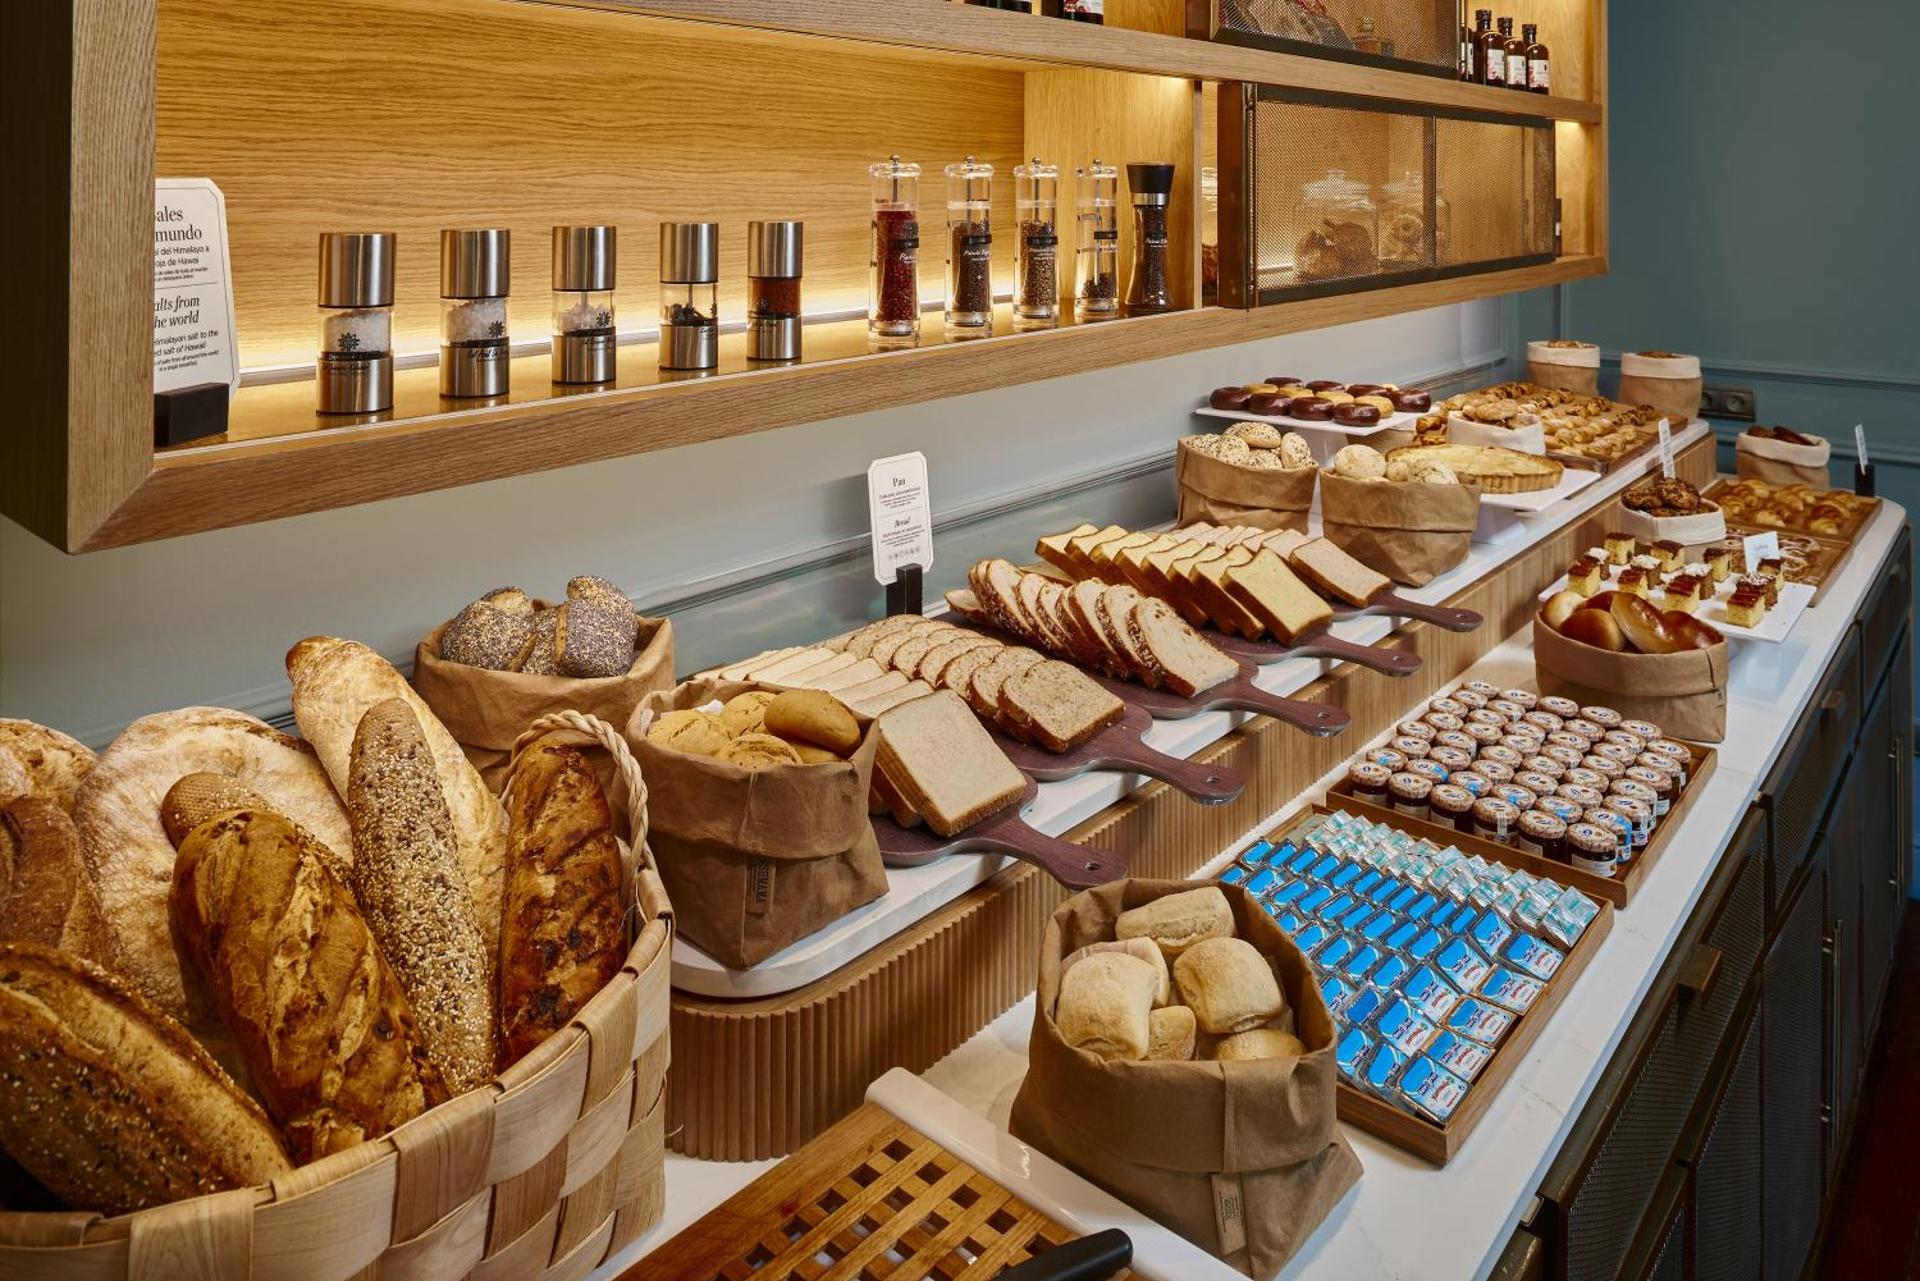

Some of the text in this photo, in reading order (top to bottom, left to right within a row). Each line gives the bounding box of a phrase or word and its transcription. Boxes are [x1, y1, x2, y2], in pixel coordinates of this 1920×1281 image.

[155, 206, 184, 222] ales
[155, 225, 202, 242] mundo
[154, 295, 200, 312] alts from
[154, 311, 199, 328] he world
